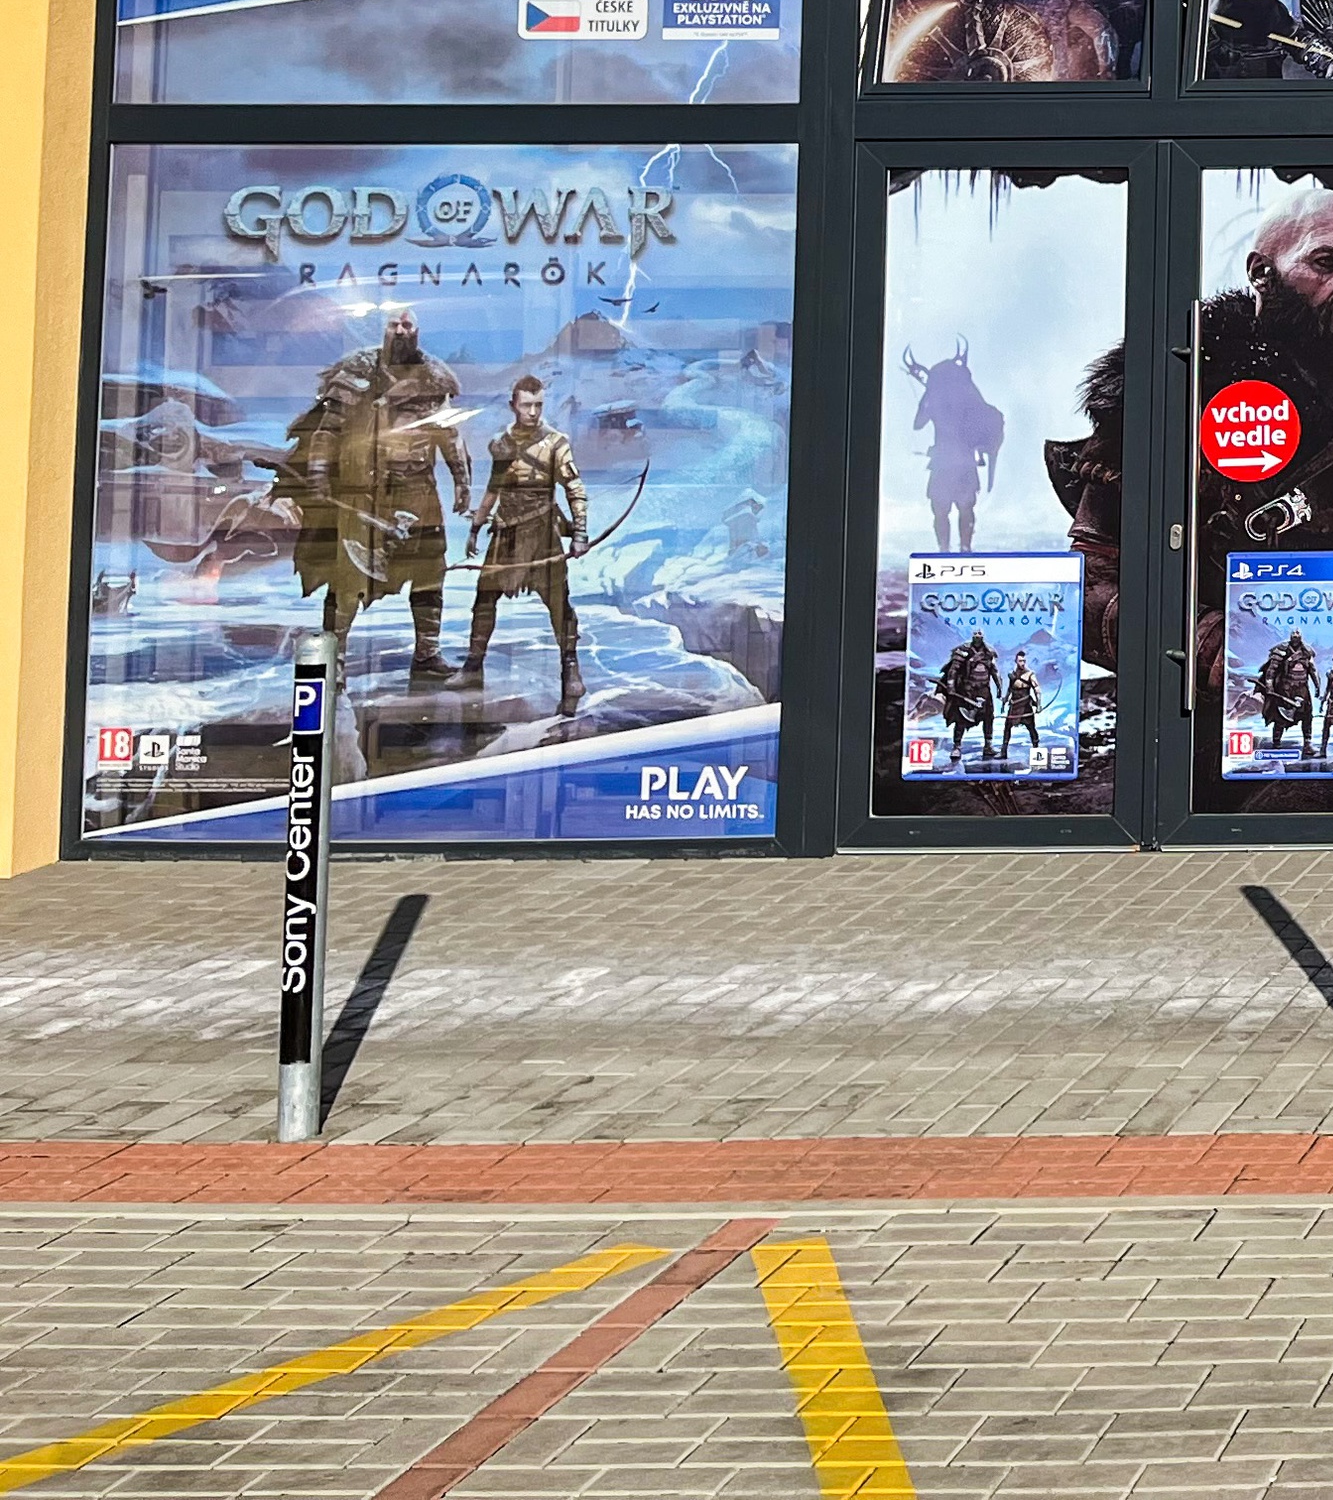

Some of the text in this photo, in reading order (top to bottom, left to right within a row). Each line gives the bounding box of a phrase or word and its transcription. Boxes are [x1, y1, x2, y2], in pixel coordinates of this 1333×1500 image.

[673, 1, 771, 13] EXKLUZIVNĚ NA
[588, 20, 640, 32] TITULKY
[677, 14, 762, 25] PLAYSTATION
[223, 185, 676, 263] GOD OF WAR
[1211, 399, 1289, 423] vchod
[1215, 425, 1287, 447] vedle
[940, 565, 986, 577] PS5
[1257, 564, 1303, 577] PS4
[920, 592, 979, 618] GOD
[1005, 592, 1065, 617] WAR
[1238, 592, 1297, 617] GOD
[294, 685, 316, 717] P
[102, 731, 130, 758] 18
[910, 742, 932, 762] 18
[1230, 734, 1251, 754] 18
[640, 765, 749, 801] PLAY
[625, 804, 661, 819] HAS
[667, 804, 694, 819] NO
[280, 747, 317, 994] Sony Center
